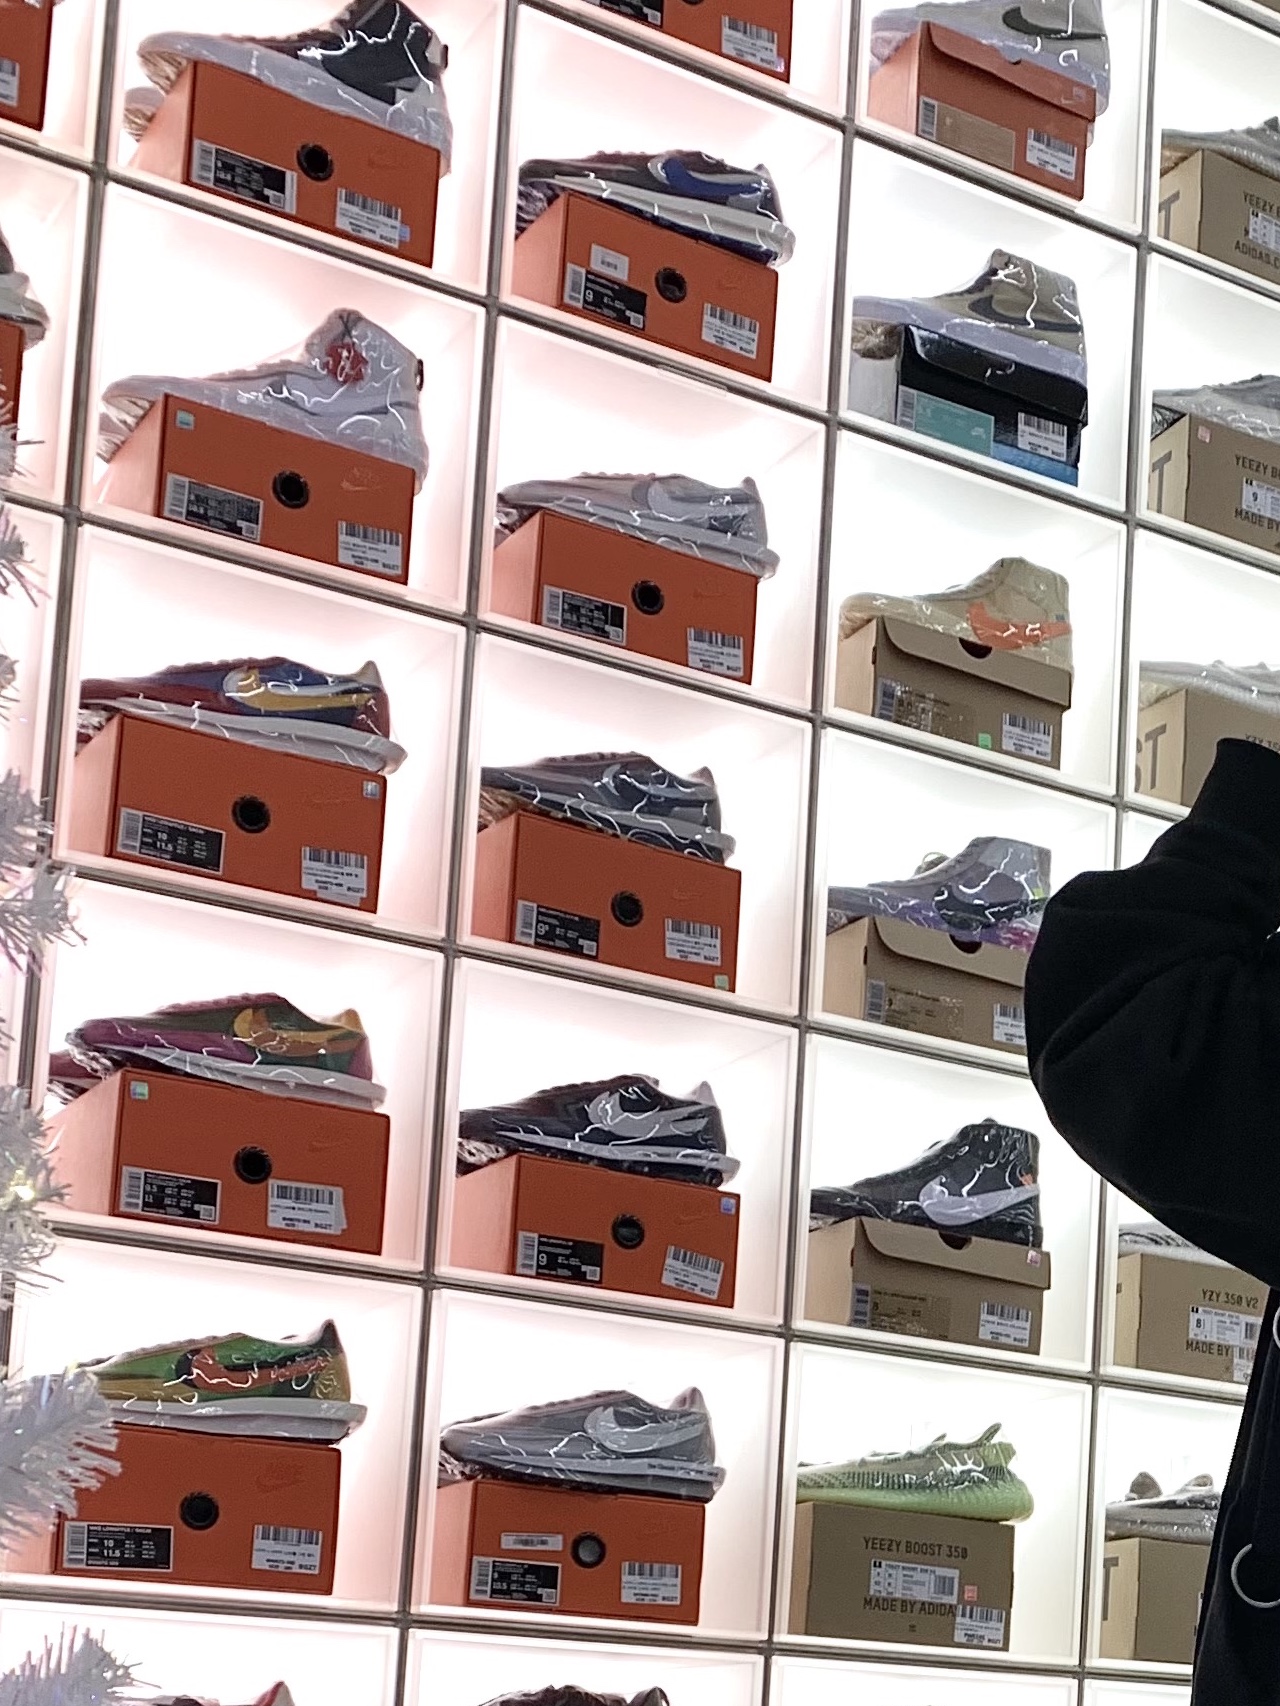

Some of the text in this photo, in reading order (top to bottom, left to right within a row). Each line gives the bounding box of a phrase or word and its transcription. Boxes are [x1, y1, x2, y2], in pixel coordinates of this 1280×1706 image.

[1243, 191, 1275, 213] YEEZY
[1235, 454, 1269, 476] YEEZY
[1234, 507, 1264, 528] MADE
[1267, 519, 1280, 532] BY
[1202, 1288, 1259, 1310] YZY 350 V2
[1186, 1340, 1231, 1357] MADE BY
[863, 1536, 968, 1560] YEEZY BOOST 350
[863, 1597, 897, 1612] MADE
[900, 1600, 918, 1614] BY
